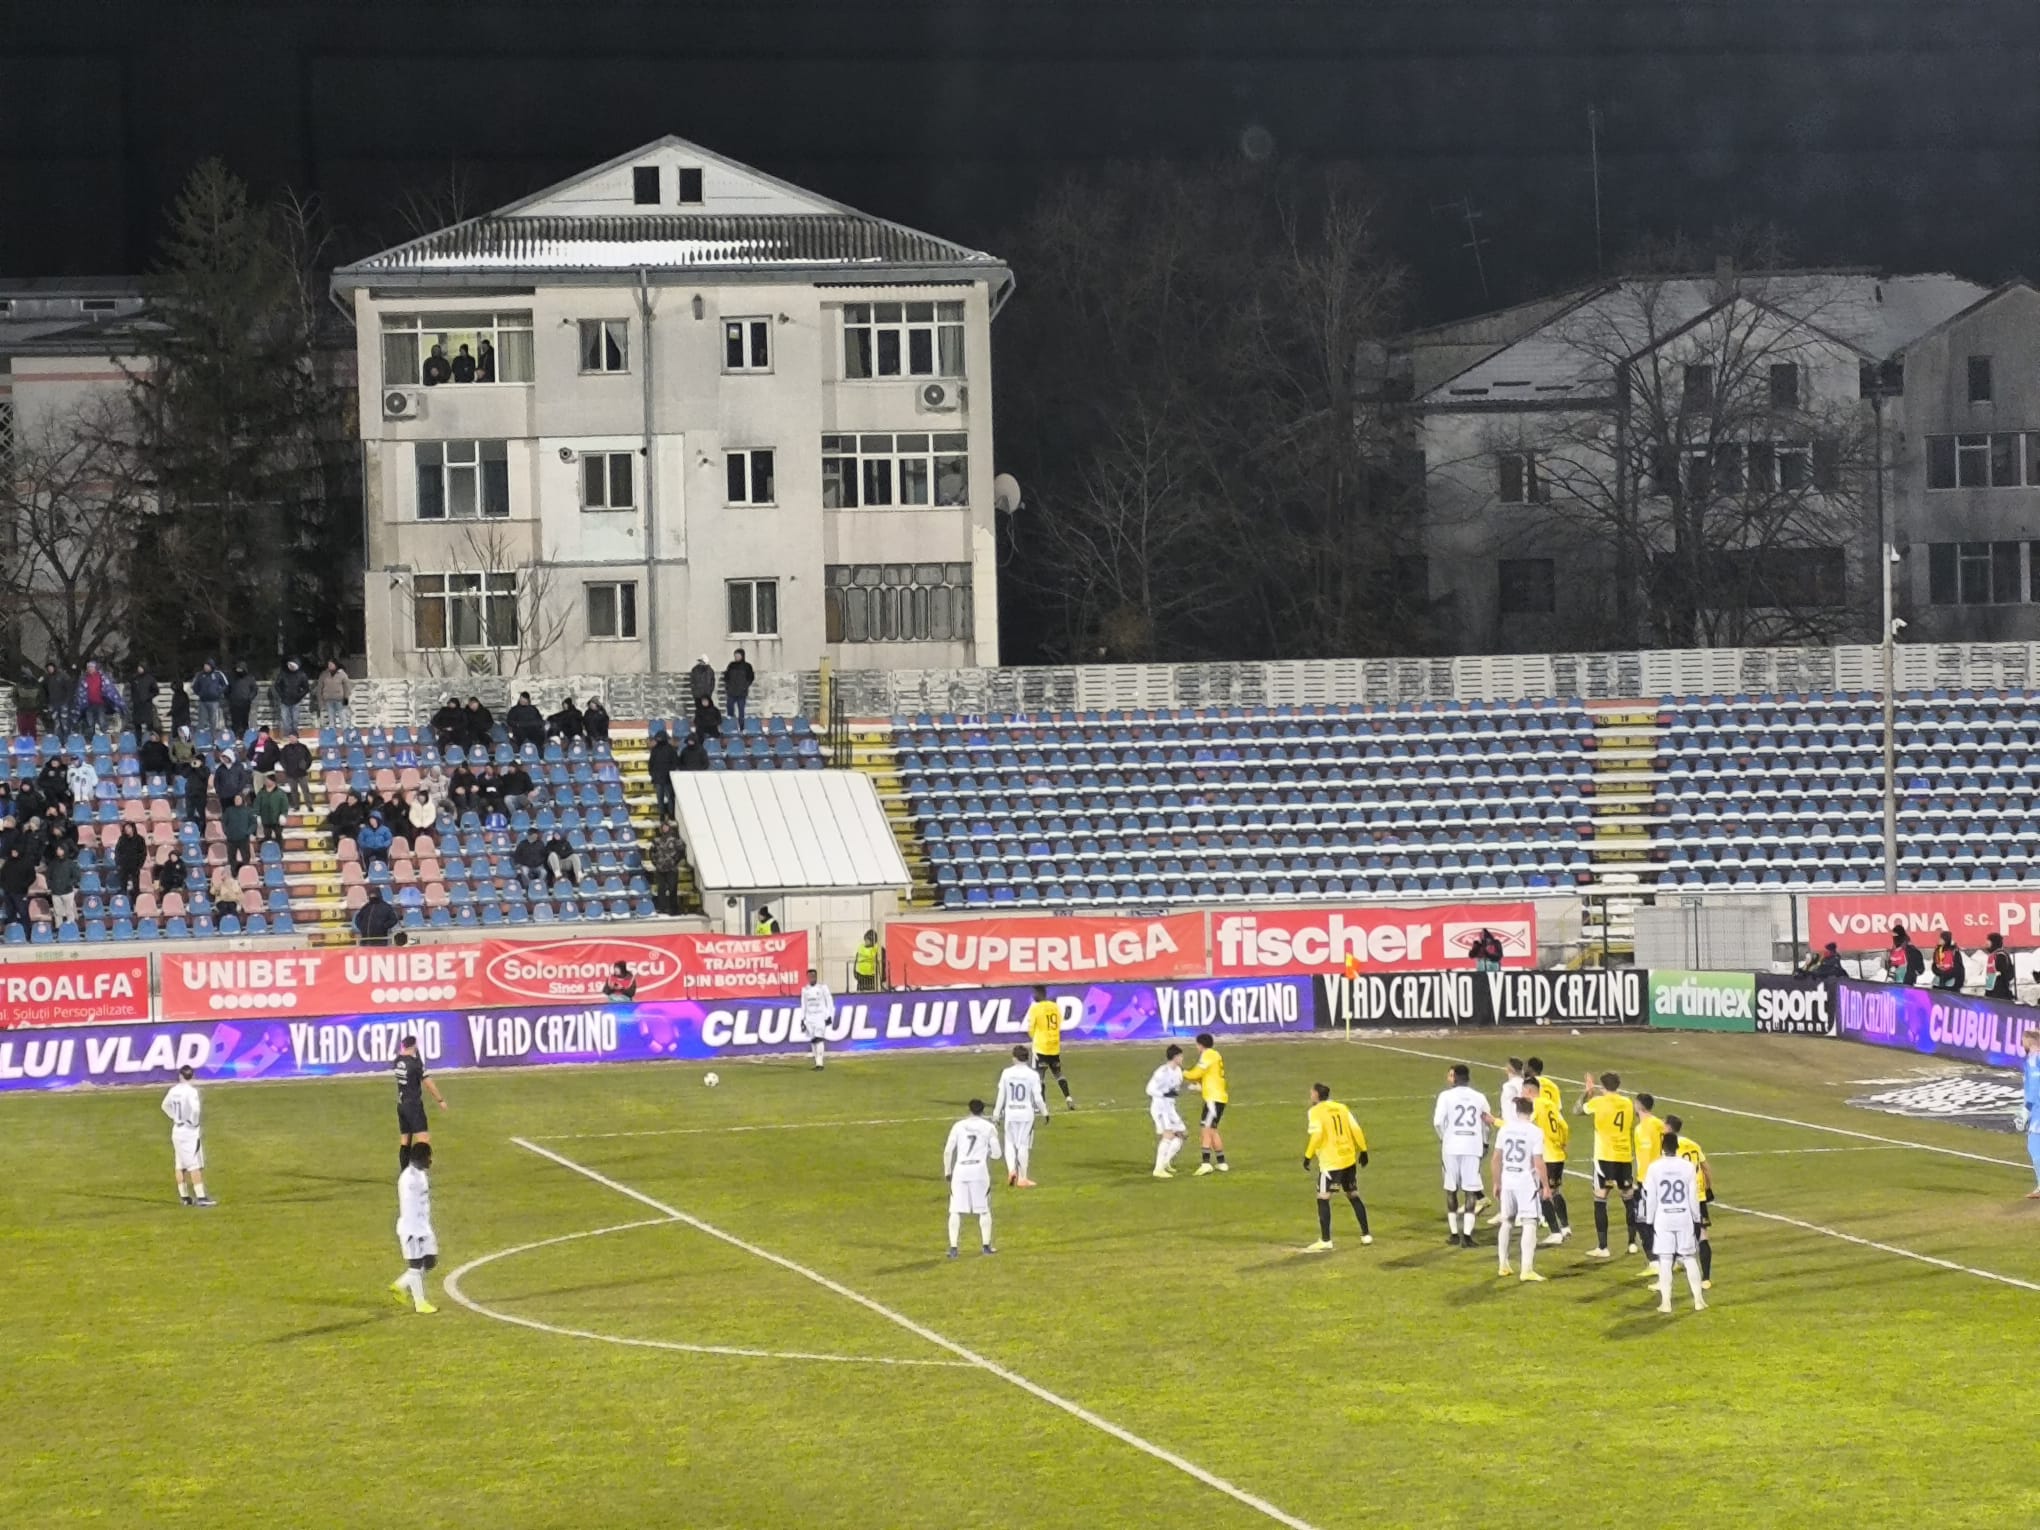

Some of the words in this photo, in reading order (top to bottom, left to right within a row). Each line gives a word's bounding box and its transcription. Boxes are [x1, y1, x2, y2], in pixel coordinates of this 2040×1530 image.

[1216, 914, 1431, 966] fischer
[1828, 912, 1949, 934] VORONA
[695, 940, 761, 954] LACTATE
[764, 939, 787, 952] CU
[912, 923, 1178, 972] SUPERLIGA
[183, 957, 321, 990] UNIBET
[345, 951, 480, 984] UNIBET
[549, 982, 585, 994] Since
[683, 975, 712, 988] DIN
[1155, 987, 1216, 1032] VLAD
[1219, 982, 1298, 1028] CAZINO
[1323, 974, 1386, 1027] VLAD
[1390, 972, 1473, 1027] CAZINO
[1487, 972, 1550, 1027] VLAD
[1554, 970, 1640, 1026] CAZINO
[1655, 976, 1752, 1018] artimex
[1757, 982, 1828, 1022] sport
[1839, 985, 1863, 1033] VLAD
[1864, 990, 1896, 1040] CAZINO
[468, 1015, 530, 1064] VLAD
[535, 1010, 616, 1057] CAZINO
[886, 1000, 959, 1038] LUI
[1046, 1012, 1058, 1031] 19
[1930, 1004, 2002, 1053] CLUBUL
[0, 1040, 74, 1079] LUI
[85, 1033, 210, 1074] VLAD
[289, 1023, 353, 1070] VLAD
[1009, 1082, 1026, 1102] 10
[1331, 1114, 1343, 1136] 11
[1454, 1104, 1477, 1127] 23
[1613, 1110, 1625, 1132] 4
[967, 1134, 977, 1157] 7
[1504, 1138, 1526, 1163] 25
[1660, 1180, 1685, 1204] 28
